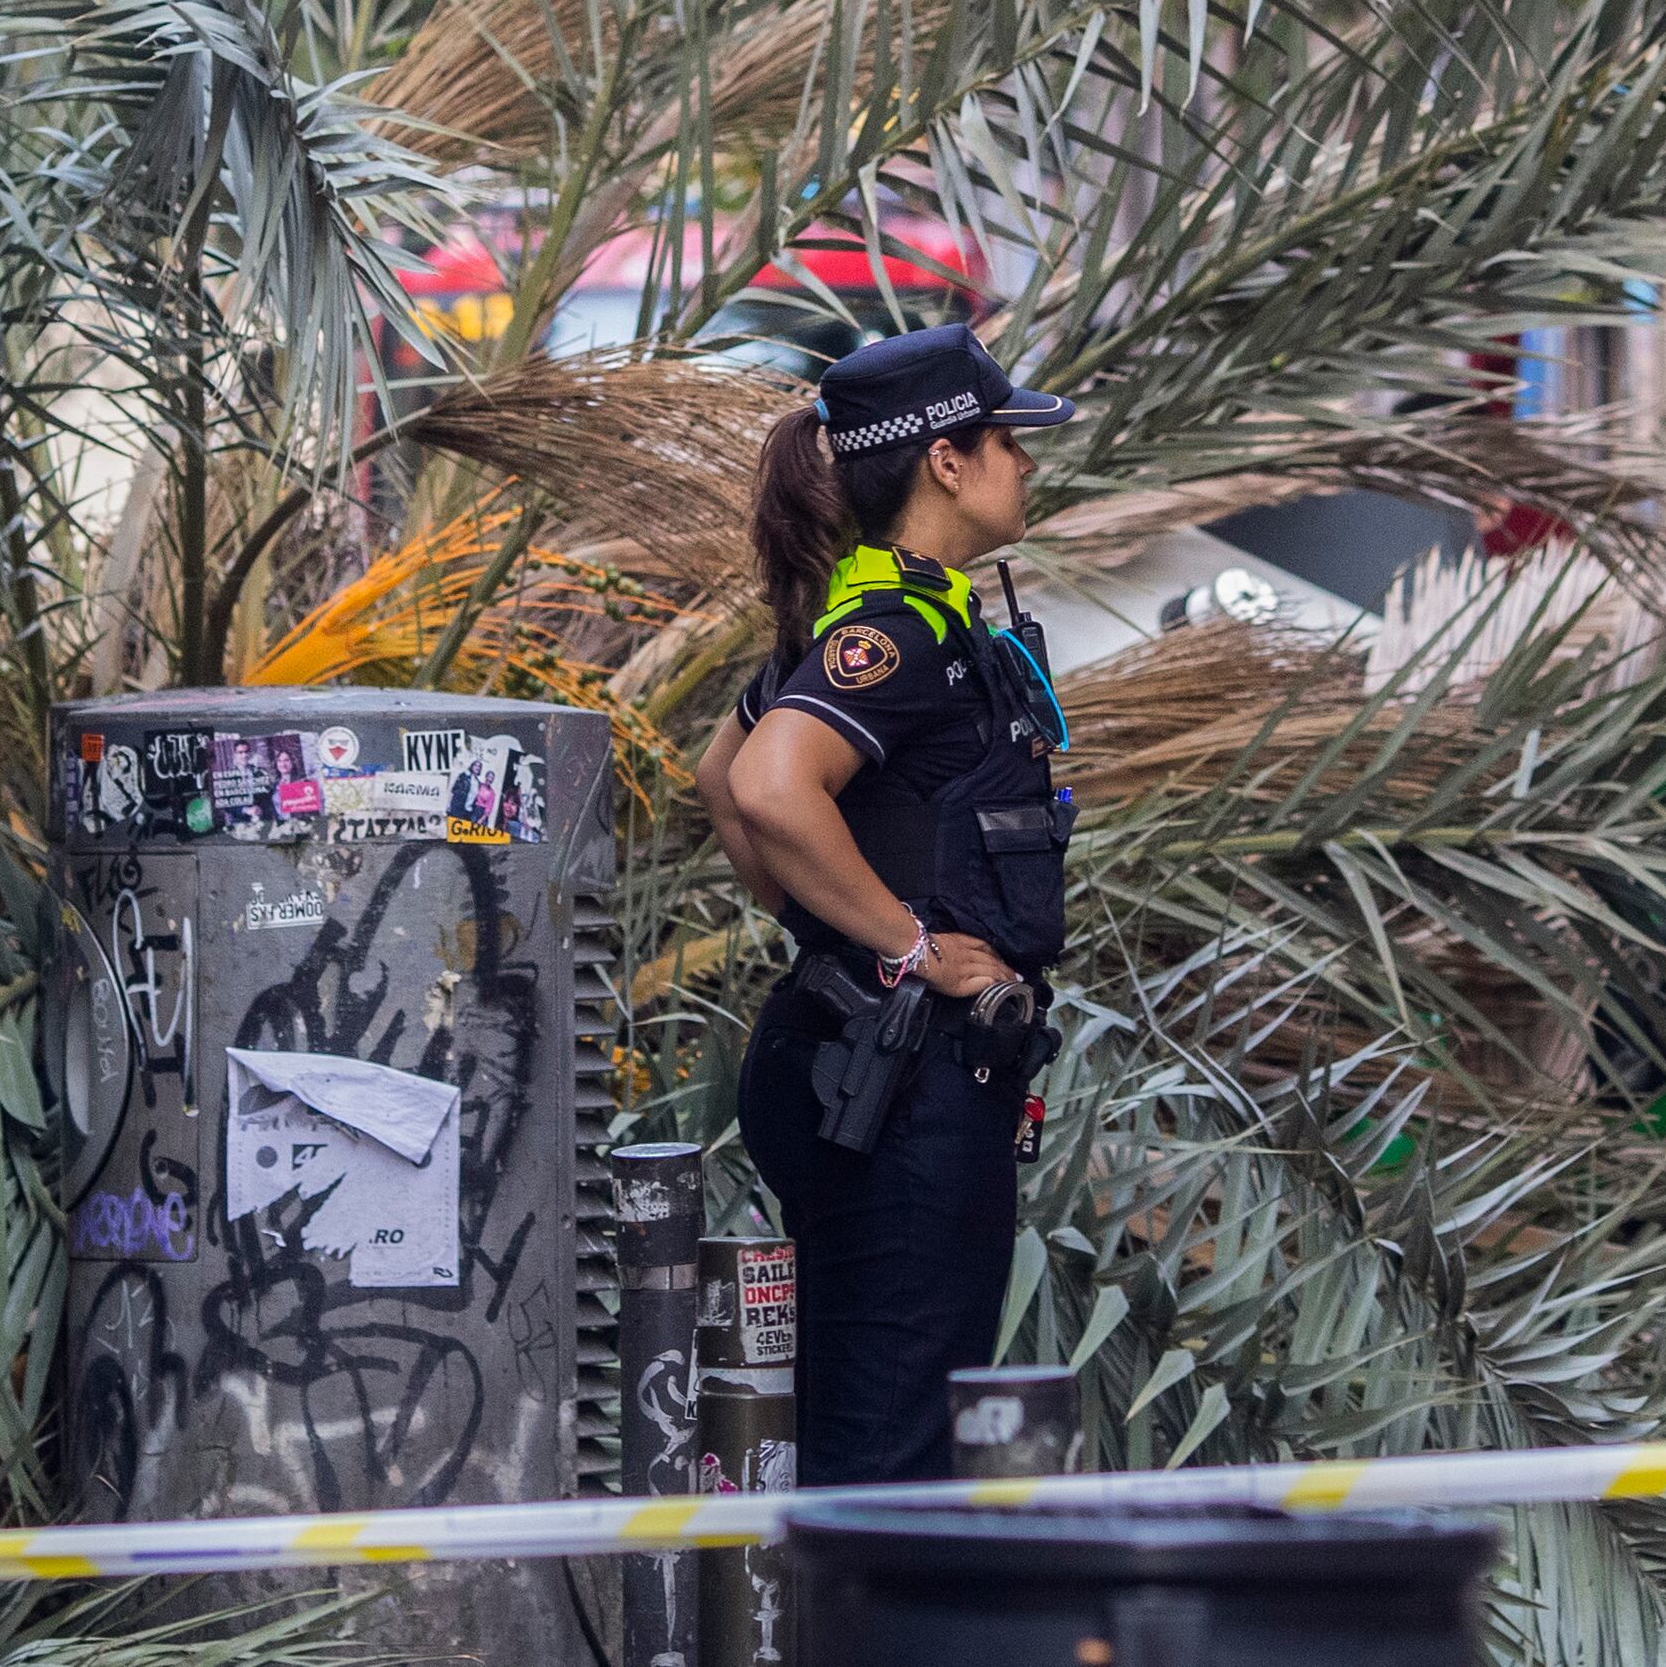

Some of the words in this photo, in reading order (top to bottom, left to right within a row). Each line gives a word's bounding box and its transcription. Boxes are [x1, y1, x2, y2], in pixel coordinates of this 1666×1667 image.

[926, 391, 979, 421] POLICIA
[841, 627, 896, 659] BARCELONA
[855, 664, 890, 684] URBANA
[383, 782, 441, 798] KARMA
